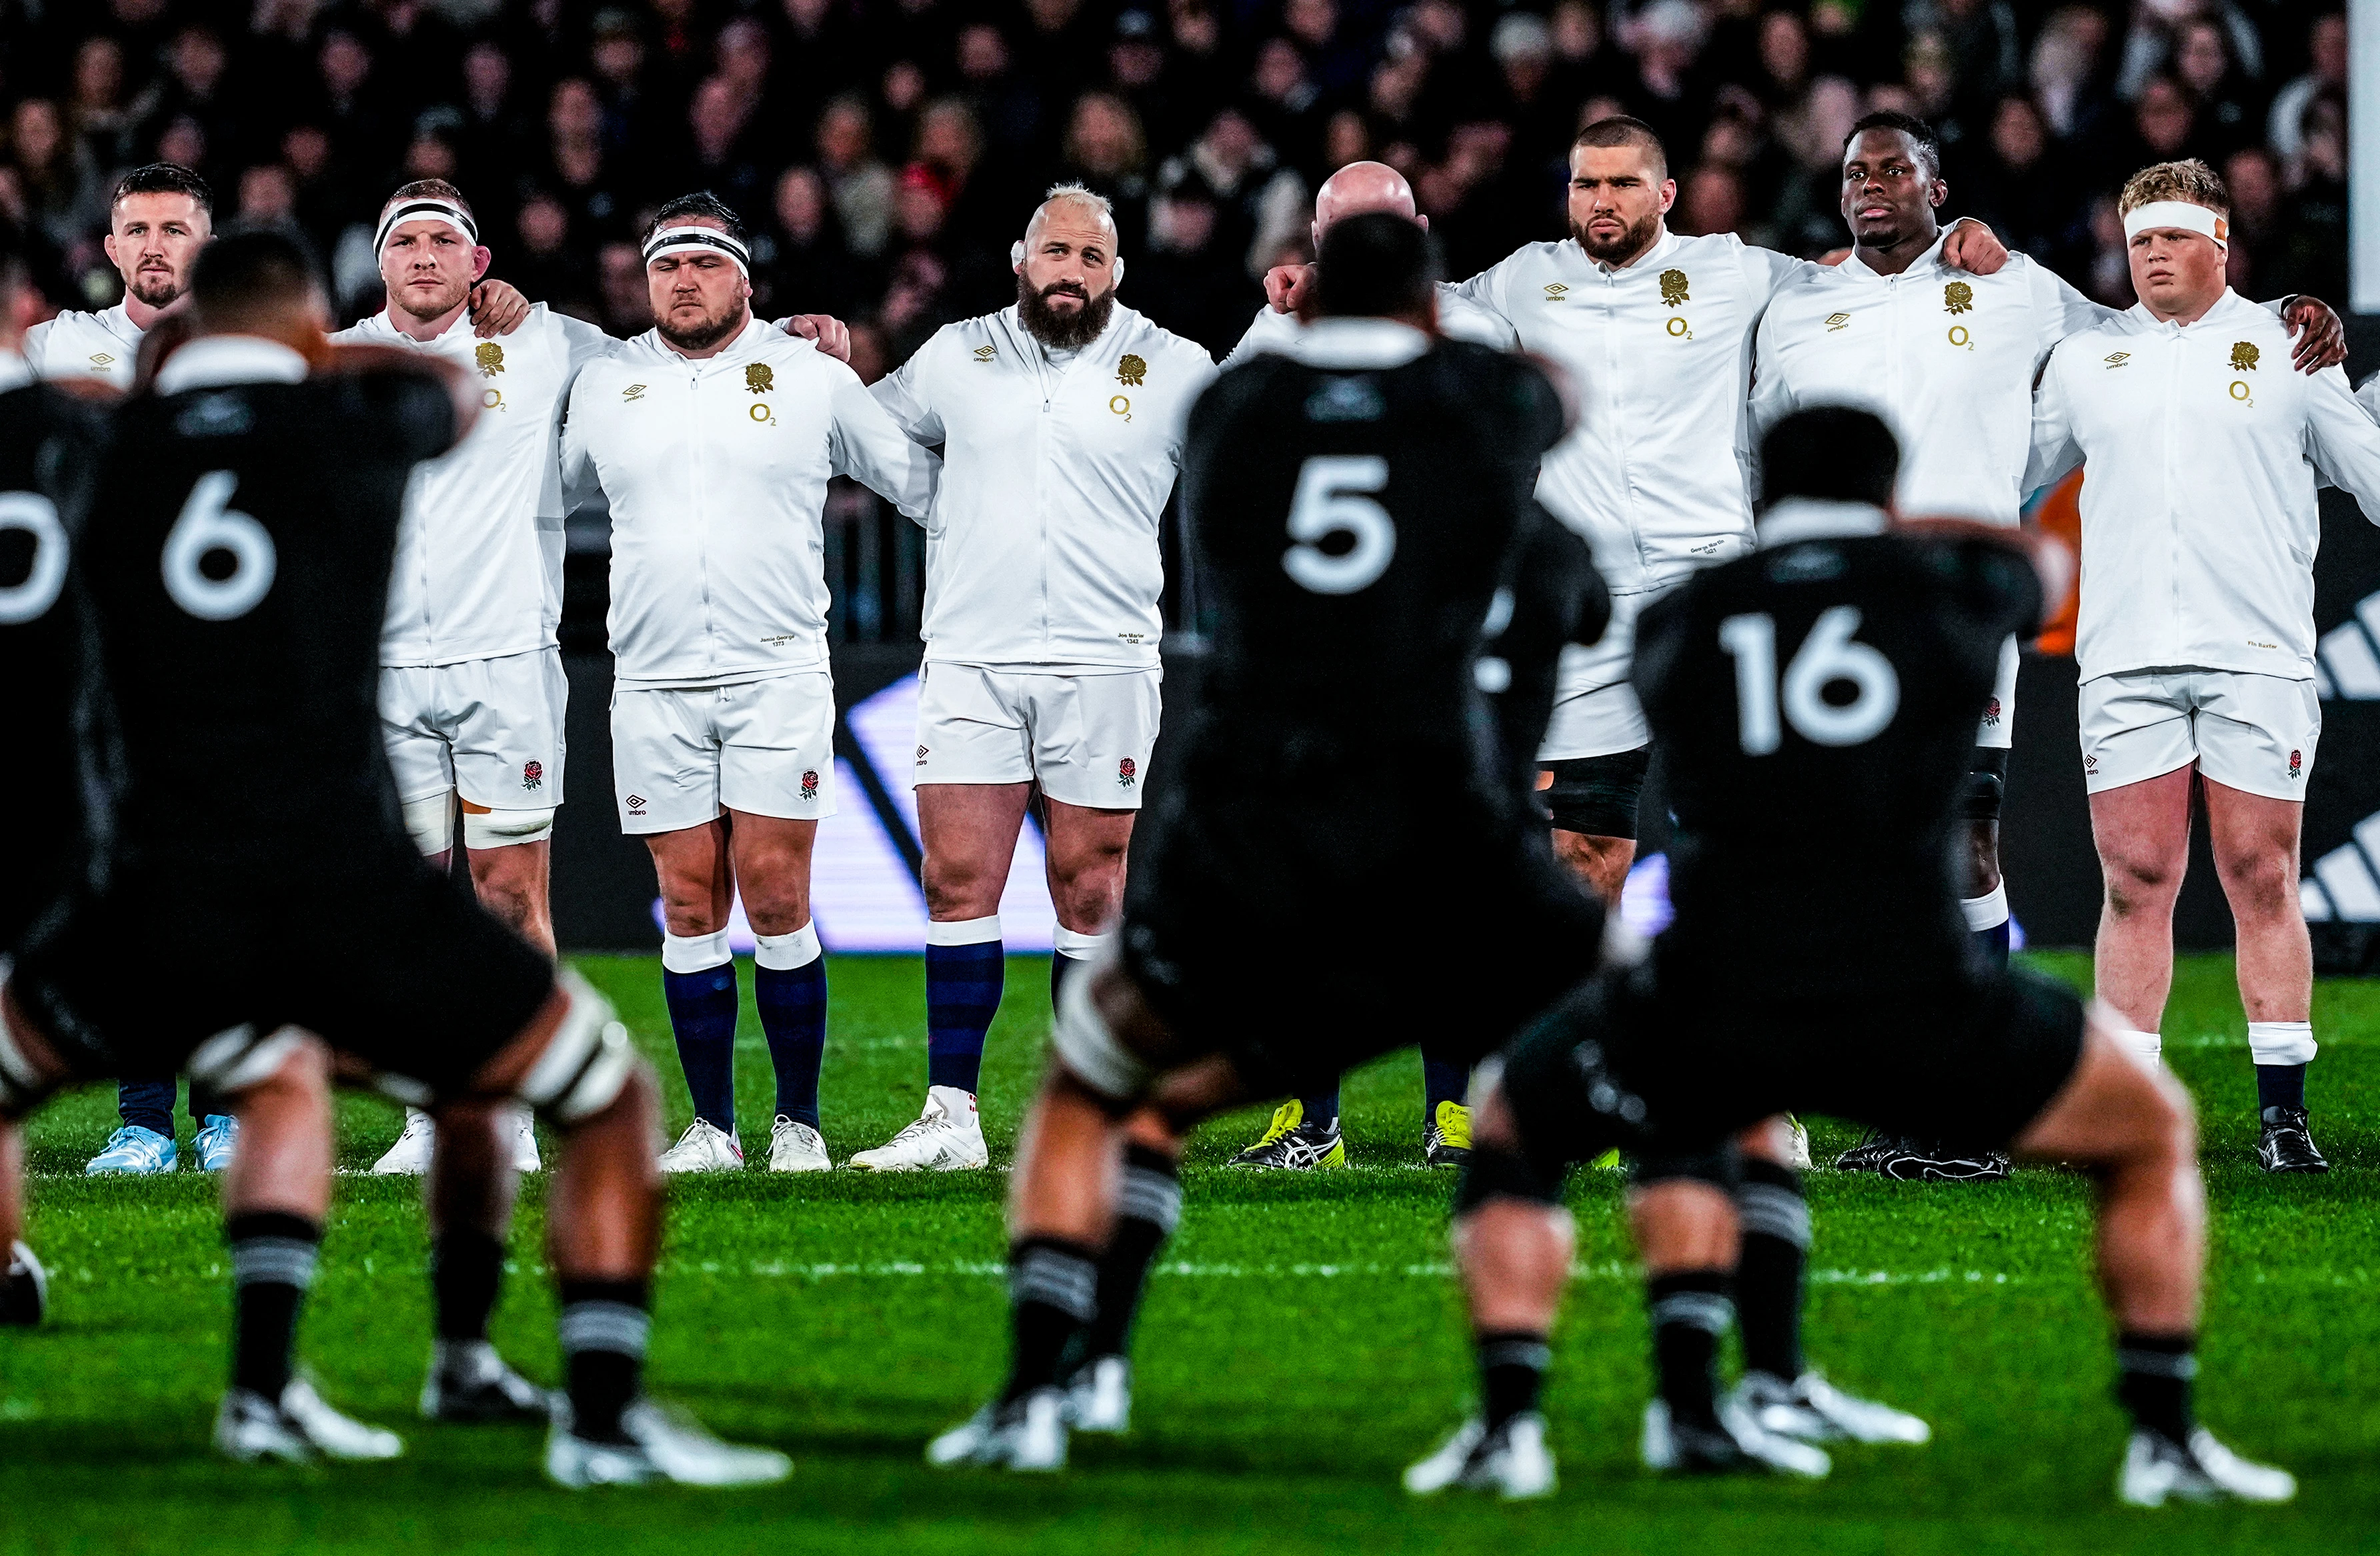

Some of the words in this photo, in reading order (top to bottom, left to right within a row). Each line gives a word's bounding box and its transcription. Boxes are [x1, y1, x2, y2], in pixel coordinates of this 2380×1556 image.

[1827, 323, 1849, 332] umbro
[624, 394, 644, 403] umbro
[2106, 361, 2128, 369] umbro
[160, 469, 277, 620] 6
[1281, 454, 1396, 594] 5
[1718, 604, 1900, 756] 16
